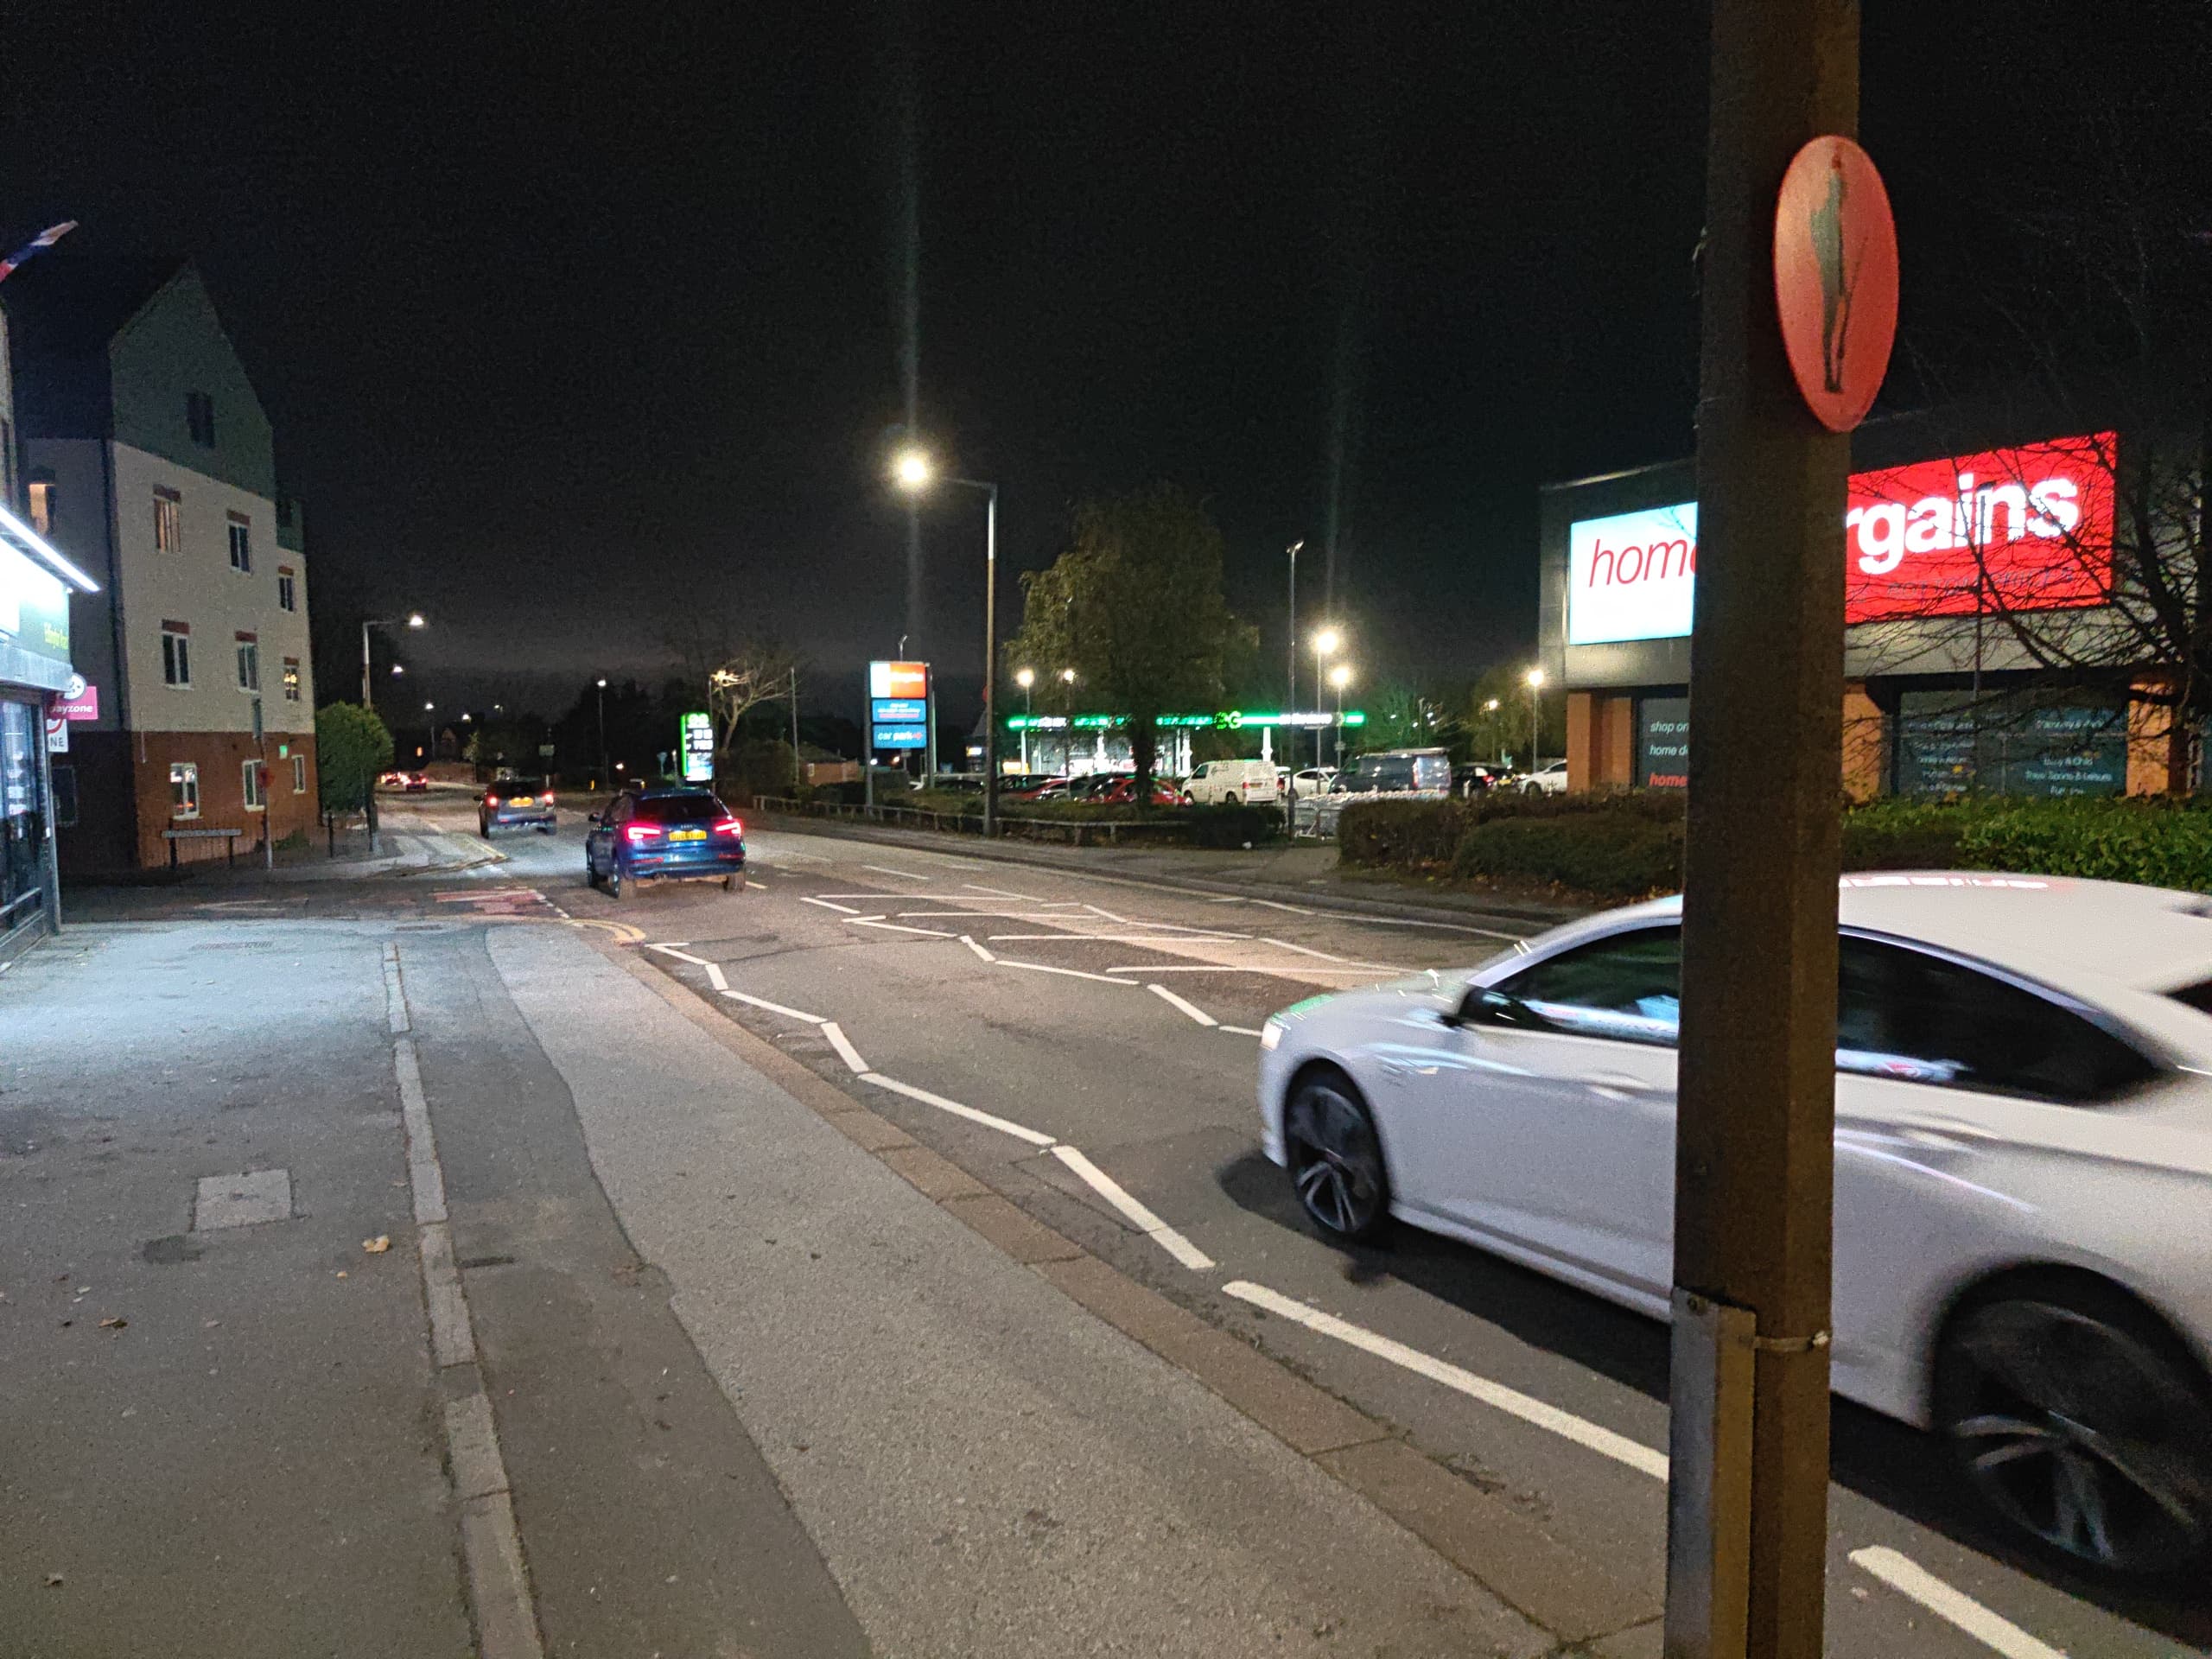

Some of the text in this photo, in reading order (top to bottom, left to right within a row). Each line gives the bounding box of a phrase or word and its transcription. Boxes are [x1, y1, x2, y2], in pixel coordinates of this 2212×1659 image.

[1847, 473, 2079, 576] gains
[1649, 721, 1675, 734] shop
[50, 736, 64, 747] NE
[893, 730, 913, 742] park
[1649, 744, 1677, 757] home
[1649, 772, 1688, 788] home
